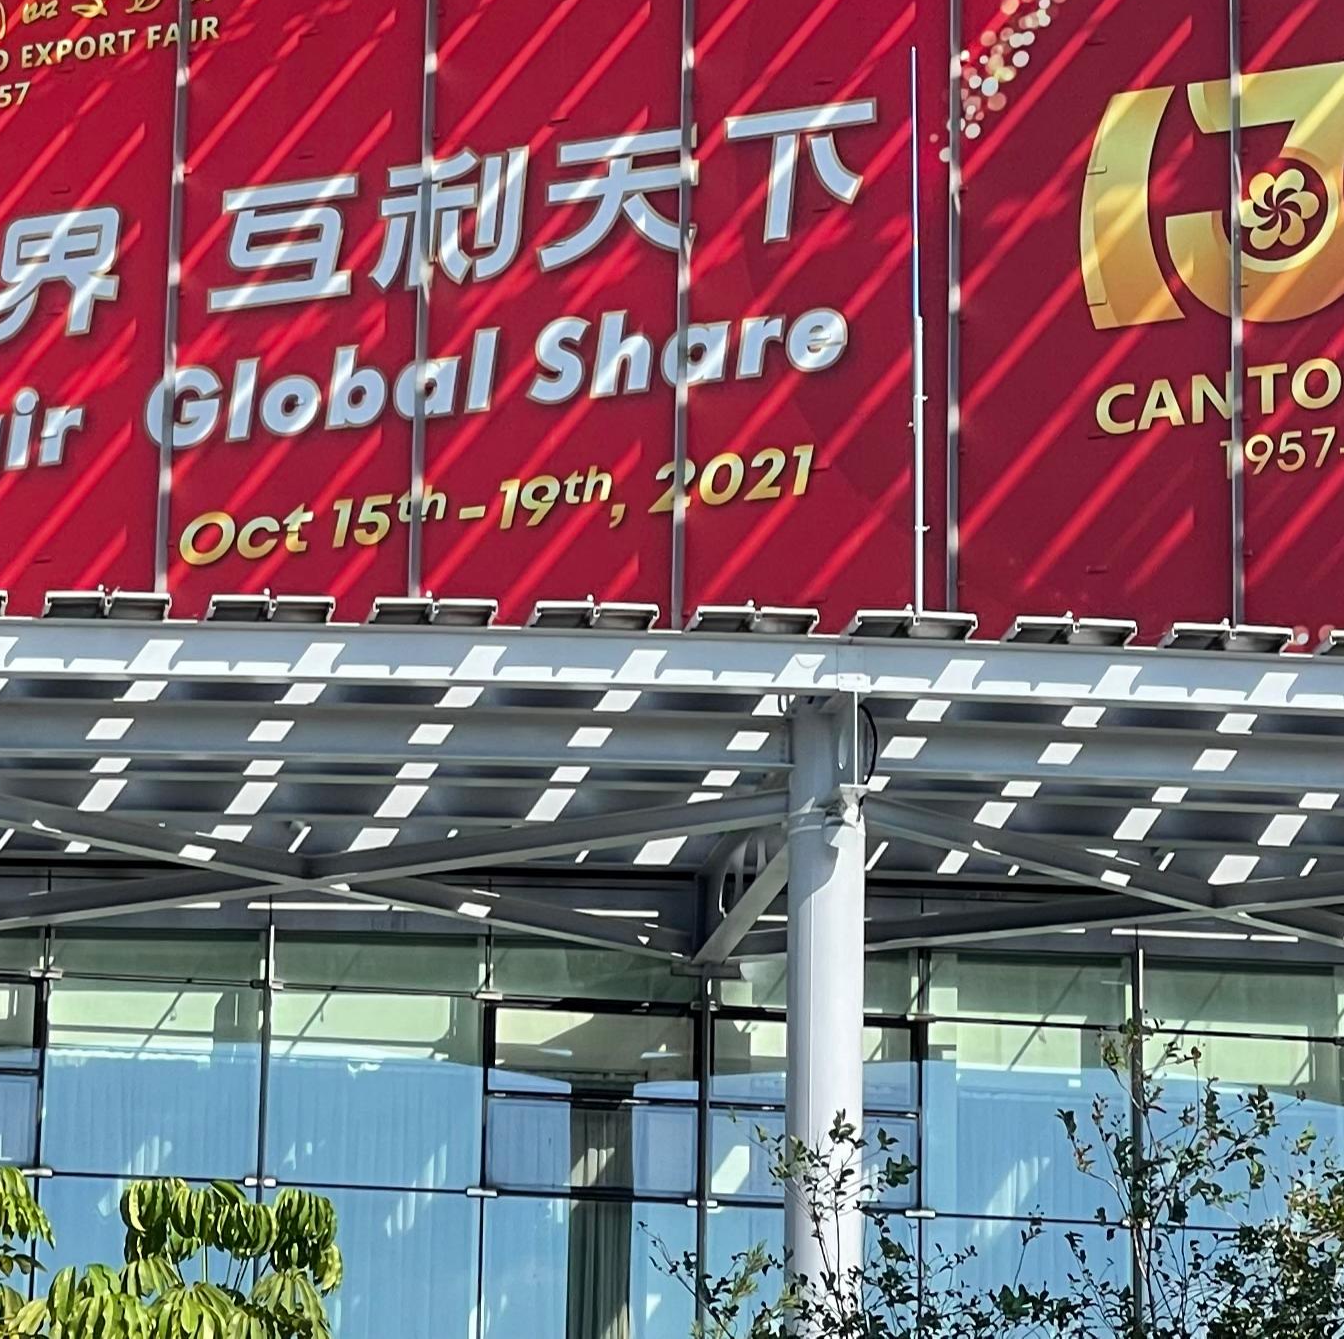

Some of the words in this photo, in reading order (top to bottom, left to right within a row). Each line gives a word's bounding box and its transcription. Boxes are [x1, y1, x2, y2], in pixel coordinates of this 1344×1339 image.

[21, 29, 136, 69] EXPORT
[147, 16, 220, 50] FAIR
[206, 97, 877, 314] 互利天下
[144, 326, 501, 450] Global
[525, 307, 848, 406] Share
[179, 503, 314, 565] Oct
[648, 444, 814, 514] 2021
